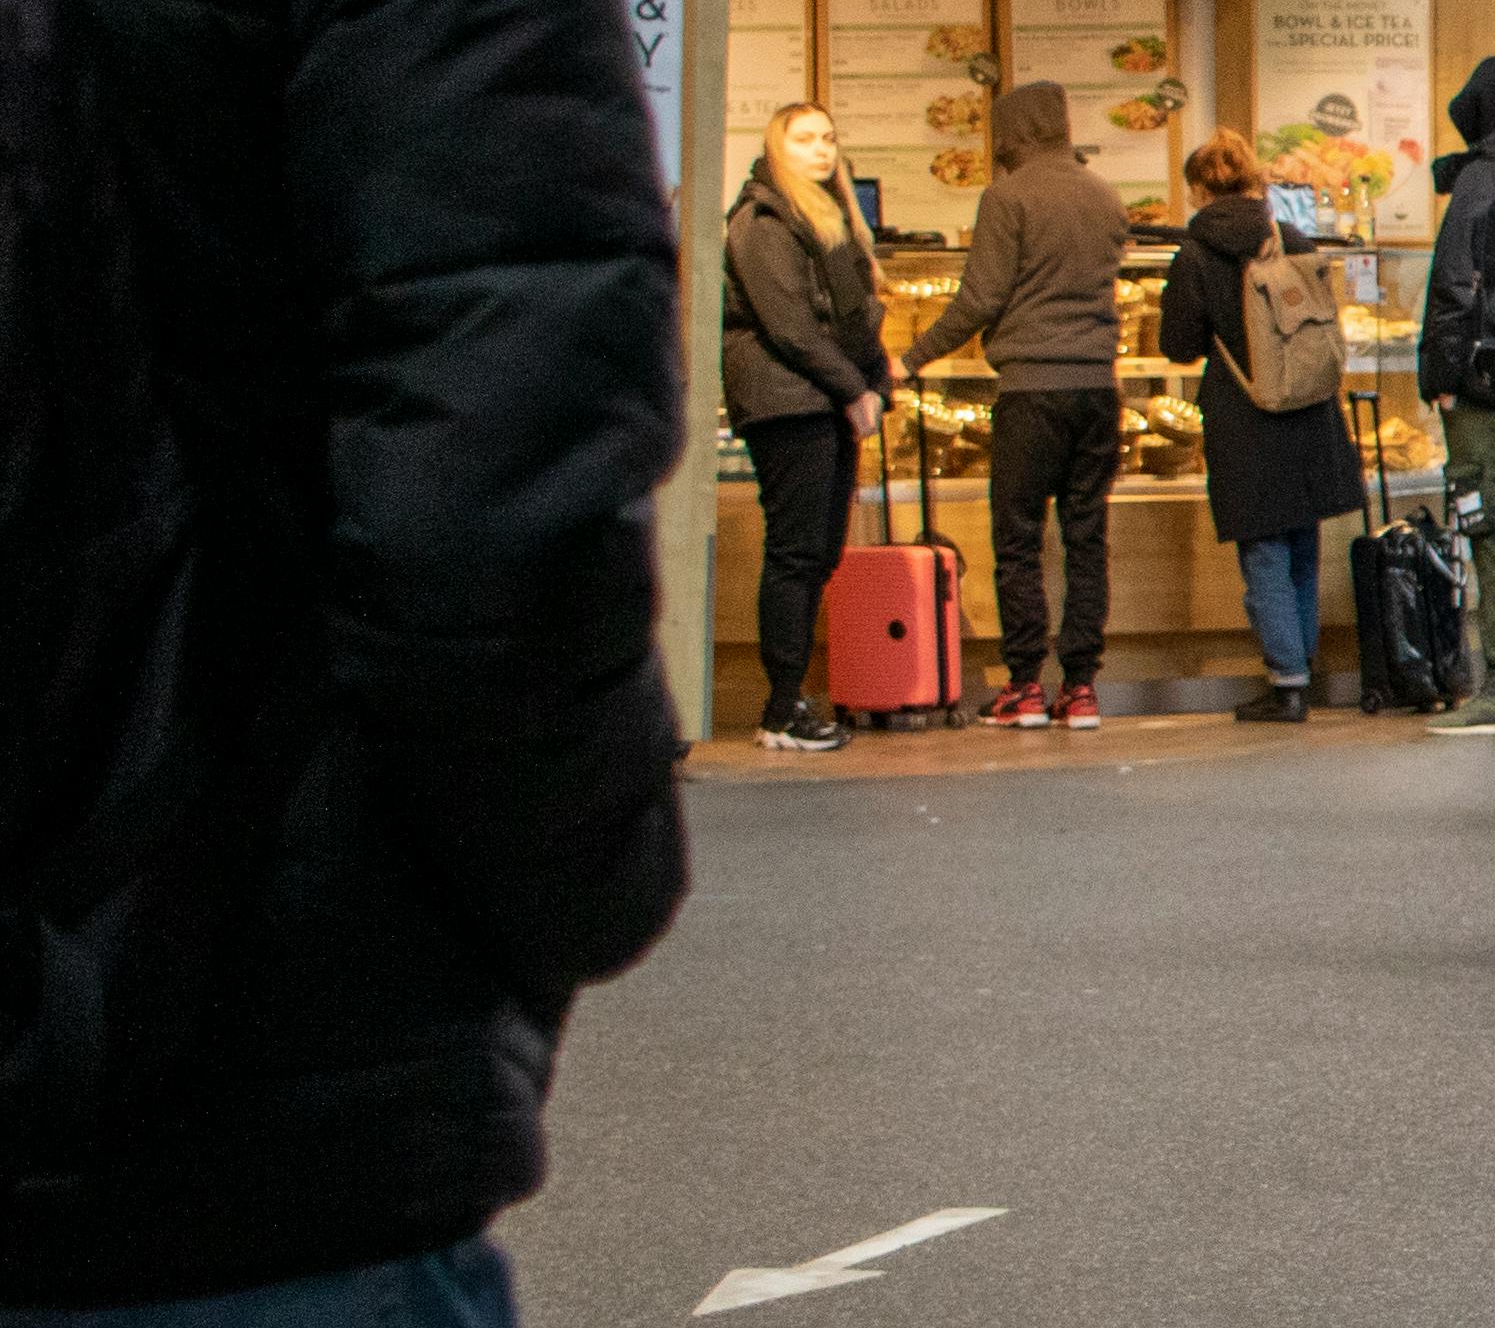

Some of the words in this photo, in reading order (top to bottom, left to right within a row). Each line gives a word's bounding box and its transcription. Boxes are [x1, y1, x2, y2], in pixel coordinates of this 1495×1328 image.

[1273, 14, 1324, 29] BOWL
[1346, 14, 1374, 29] ICE
[1381, 14, 1412, 29] TEA
[1288, 33, 1358, 48] SPECIAL
